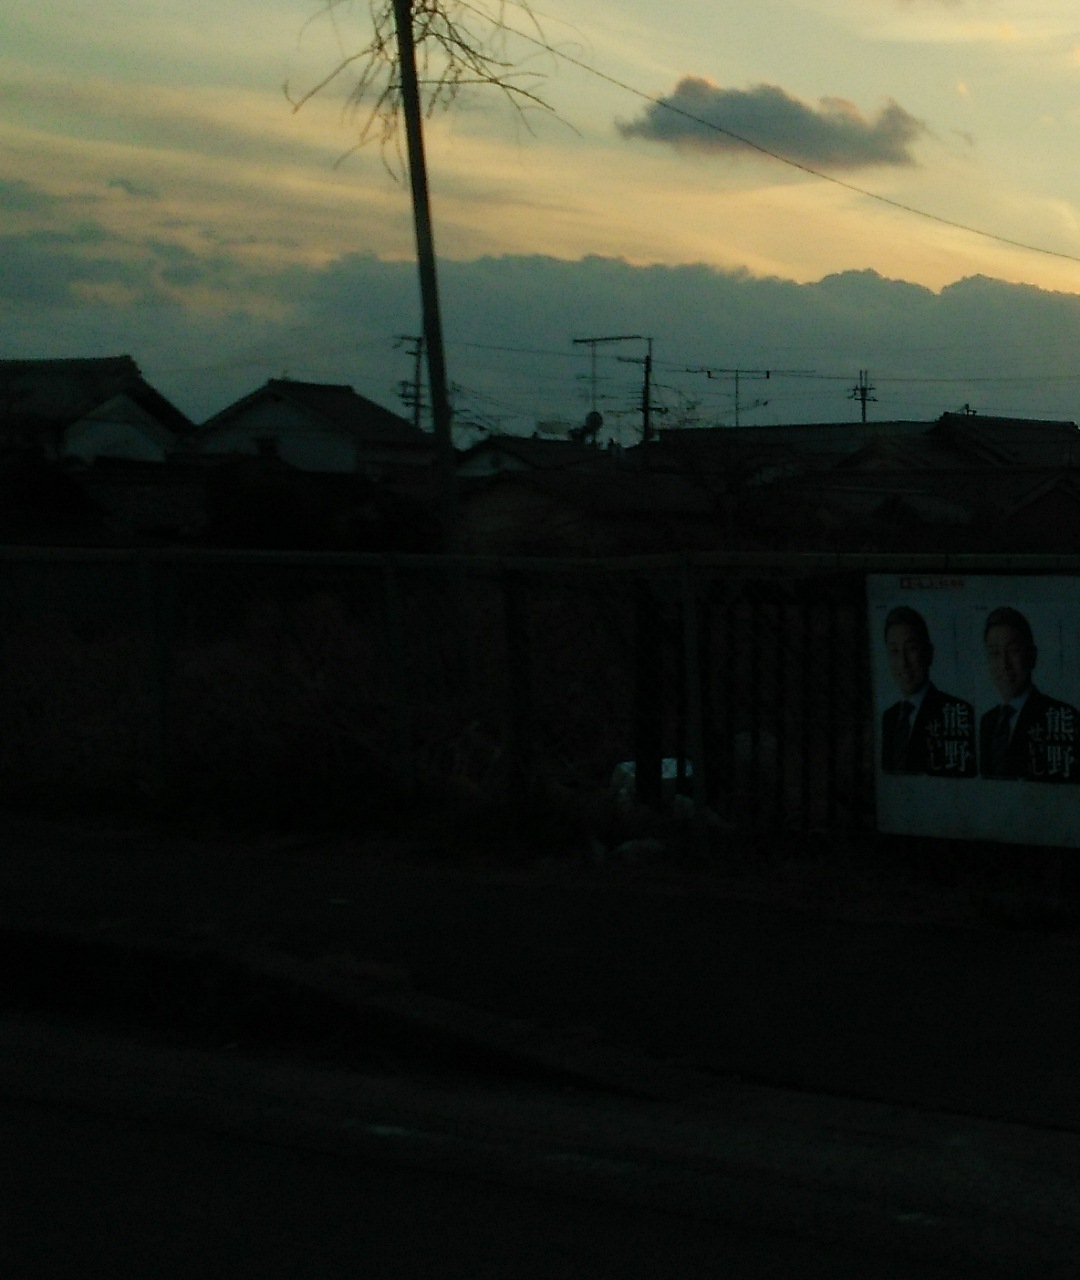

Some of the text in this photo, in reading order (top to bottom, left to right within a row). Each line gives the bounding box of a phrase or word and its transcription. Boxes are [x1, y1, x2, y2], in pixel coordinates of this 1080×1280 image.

[925, 720, 942, 771] せいし
[942, 702, 974, 772] 熊野
[1027, 722, 1046, 776] せいし
[1045, 705, 1076, 779] 熊野
